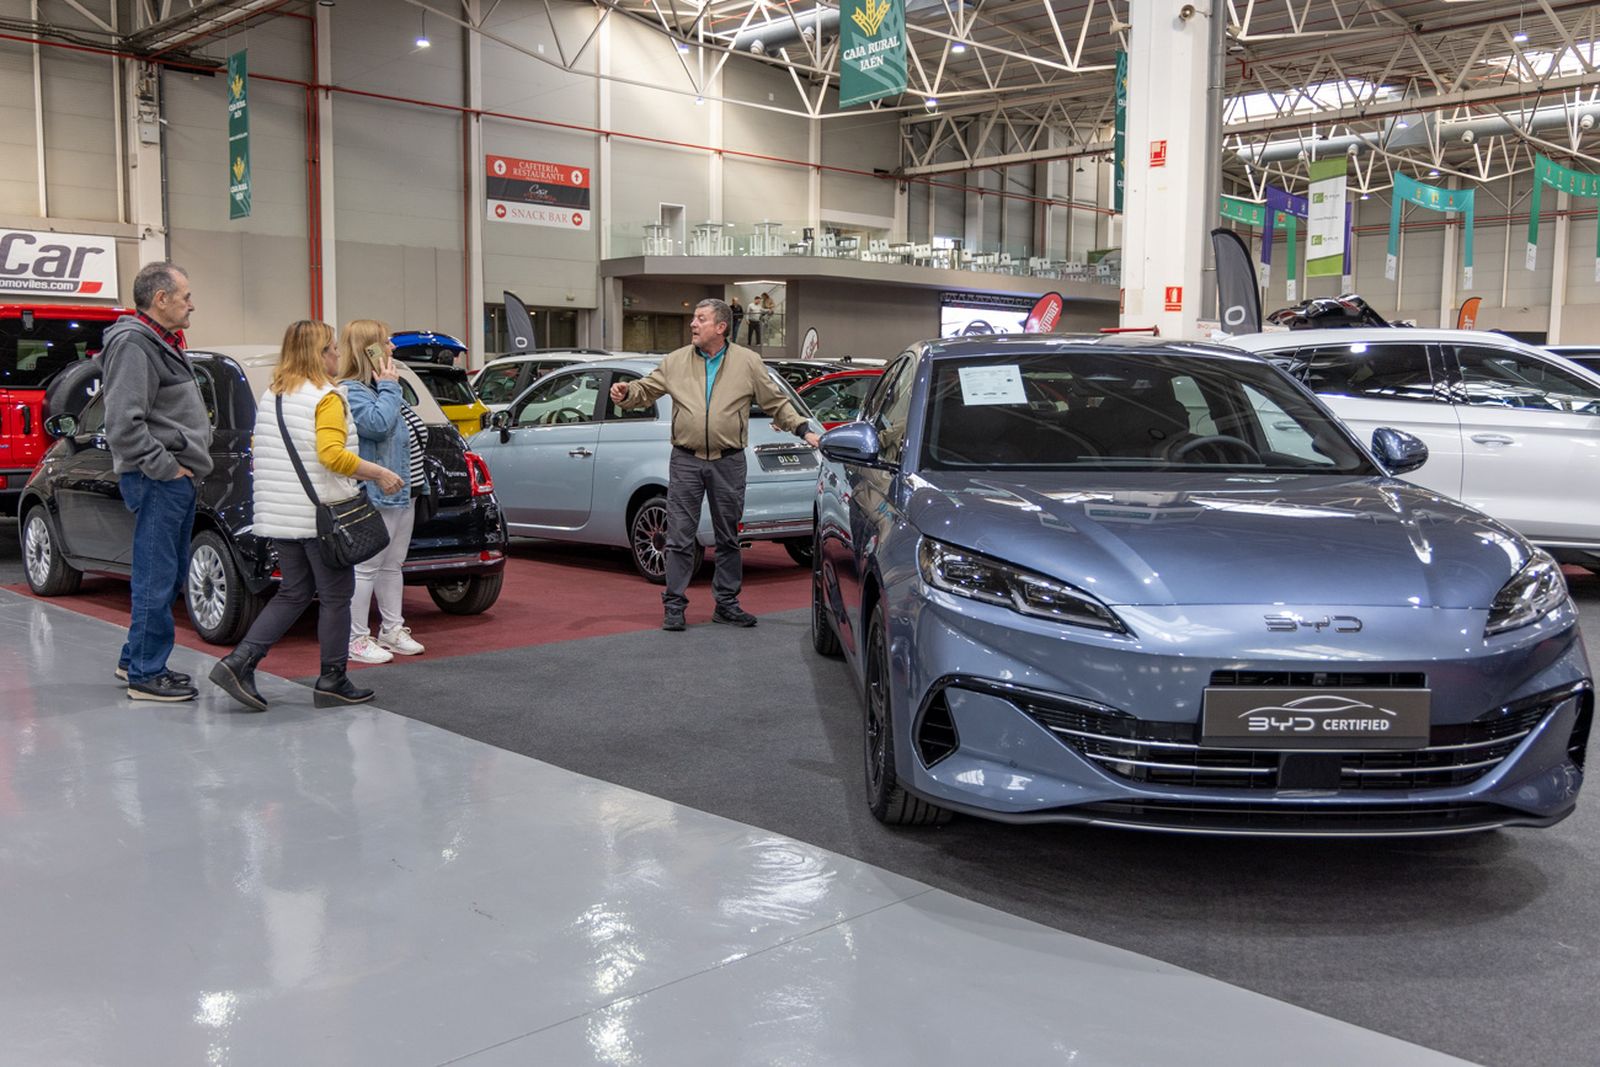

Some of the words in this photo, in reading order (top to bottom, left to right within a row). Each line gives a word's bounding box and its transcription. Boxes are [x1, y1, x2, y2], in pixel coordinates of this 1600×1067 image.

[843, 45, 866, 60] CAJA
[868, 36, 900, 53] RURAL
[860, 54, 884, 72] JAÉN
[519, 161, 558, 173] CAFETERÍA
[513, 168, 565, 182] RESTAURANTE
[511, 209, 545, 220] SNACK
[548, 212, 568, 223] BAR
[1263, 614, 1363, 633] BYD
[1248, 717, 1315, 731] BYD
[1322, 718, 1390, 731] CERTIFIED
